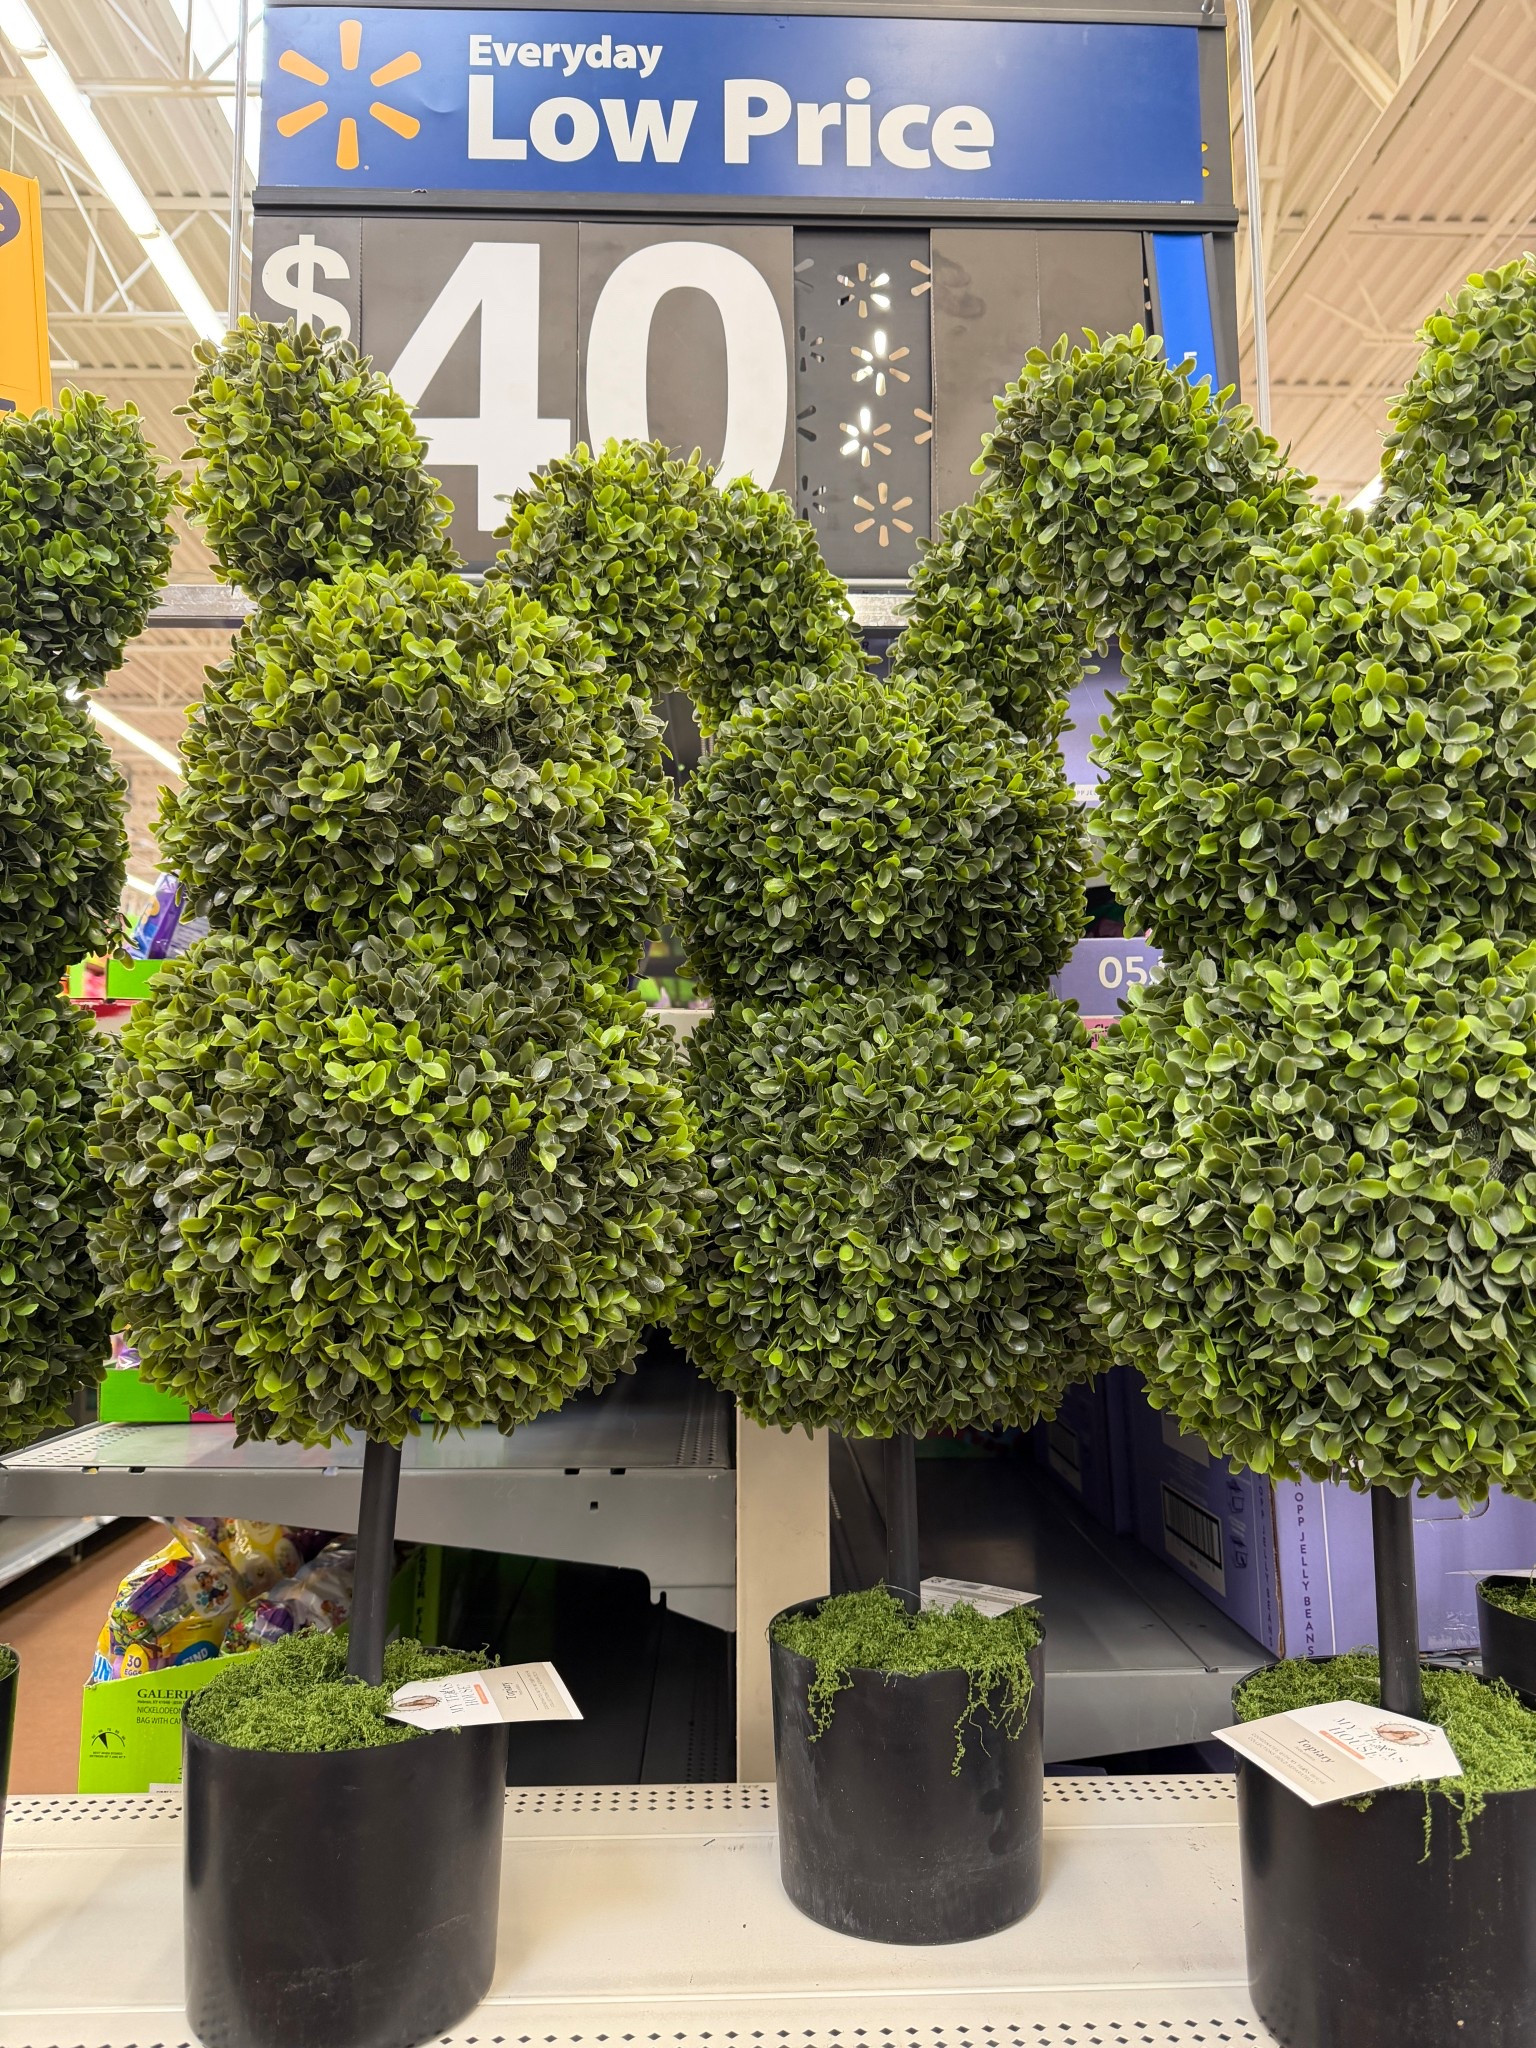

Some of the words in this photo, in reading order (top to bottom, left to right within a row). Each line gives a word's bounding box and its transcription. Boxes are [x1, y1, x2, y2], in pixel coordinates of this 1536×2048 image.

[469, 34, 663, 78] Everyday
[468, 74, 698, 163] Low
[724, 77, 994, 170] Price
[1299, 1531, 1310, 1591] JELLY
[1304, 1596, 1315, 1656] BEANS
[126, 1654, 142, 1669] 30
[136, 1716, 151, 1725] BAG
[152, 1716, 169, 1725] WITH
[1298, 1738, 1335, 1763] Topiary
[1328, 1726, 1380, 1760] HOUSE
